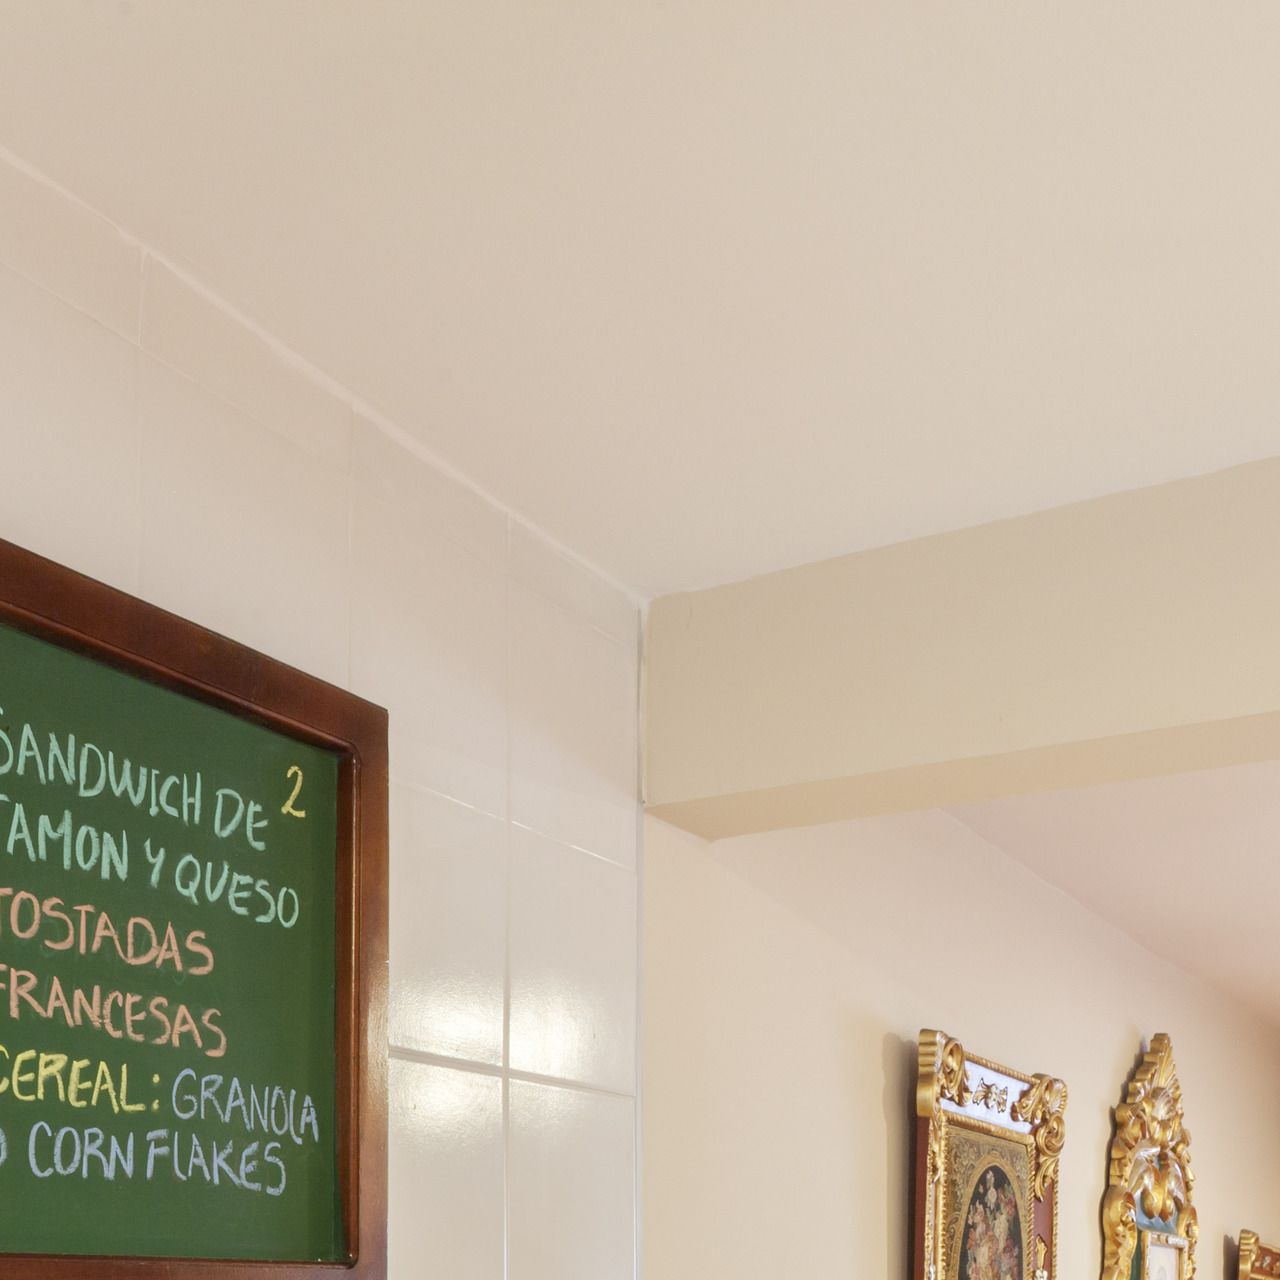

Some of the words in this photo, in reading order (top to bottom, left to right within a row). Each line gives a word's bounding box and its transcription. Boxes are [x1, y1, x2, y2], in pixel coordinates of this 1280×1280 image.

[214, 788, 269, 851] DE
[281, 766, 306, 817] 2
[144, 837, 166, 888] Y
[175, 854, 300, 928] QUESO
[172, 1068, 320, 1145] GRANOLA
